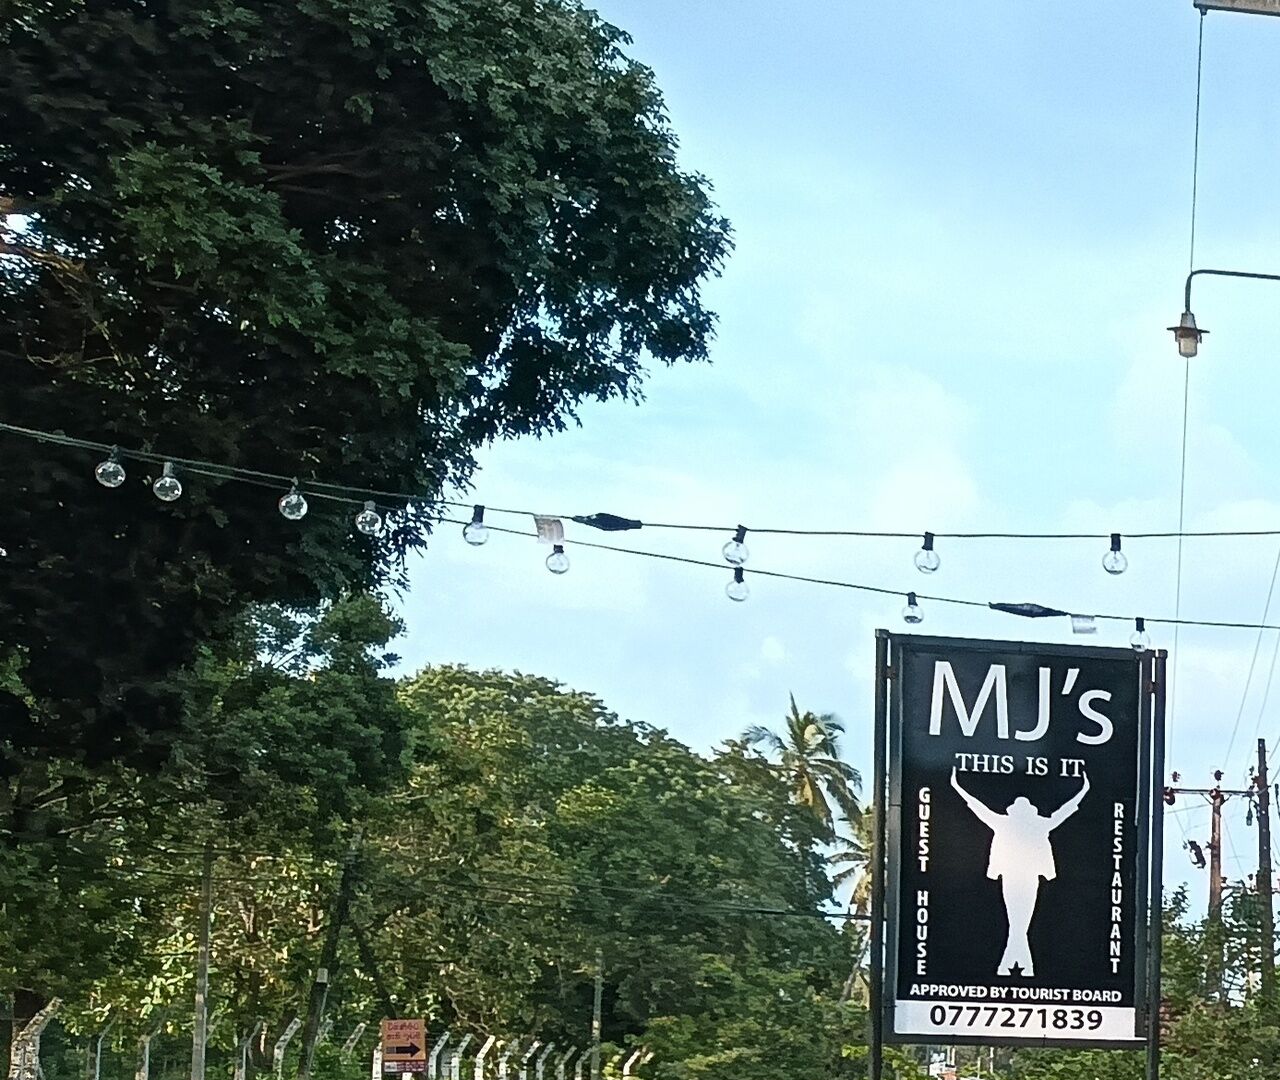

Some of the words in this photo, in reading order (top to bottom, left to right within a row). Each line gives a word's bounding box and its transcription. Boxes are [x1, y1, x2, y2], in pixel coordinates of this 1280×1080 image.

[928, 660, 1114, 745] MJ's
[955, 752, 1014, 775] THIS
[1025, 756, 1049, 776] IS
[1059, 758, 1086, 778] IT
[917, 786, 931, 873] GUEST
[1109, 802, 1124, 974] RESTAURANT
[916, 890, 929, 975] HOUSE
[910, 983, 988, 999] APPROVED
[990, 986, 1009, 999] BY
[1012, 987, 1072, 1000] TOURIST
[1073, 989, 1122, 1003] BOARD
[929, 1004, 1103, 1031] 0777271839
